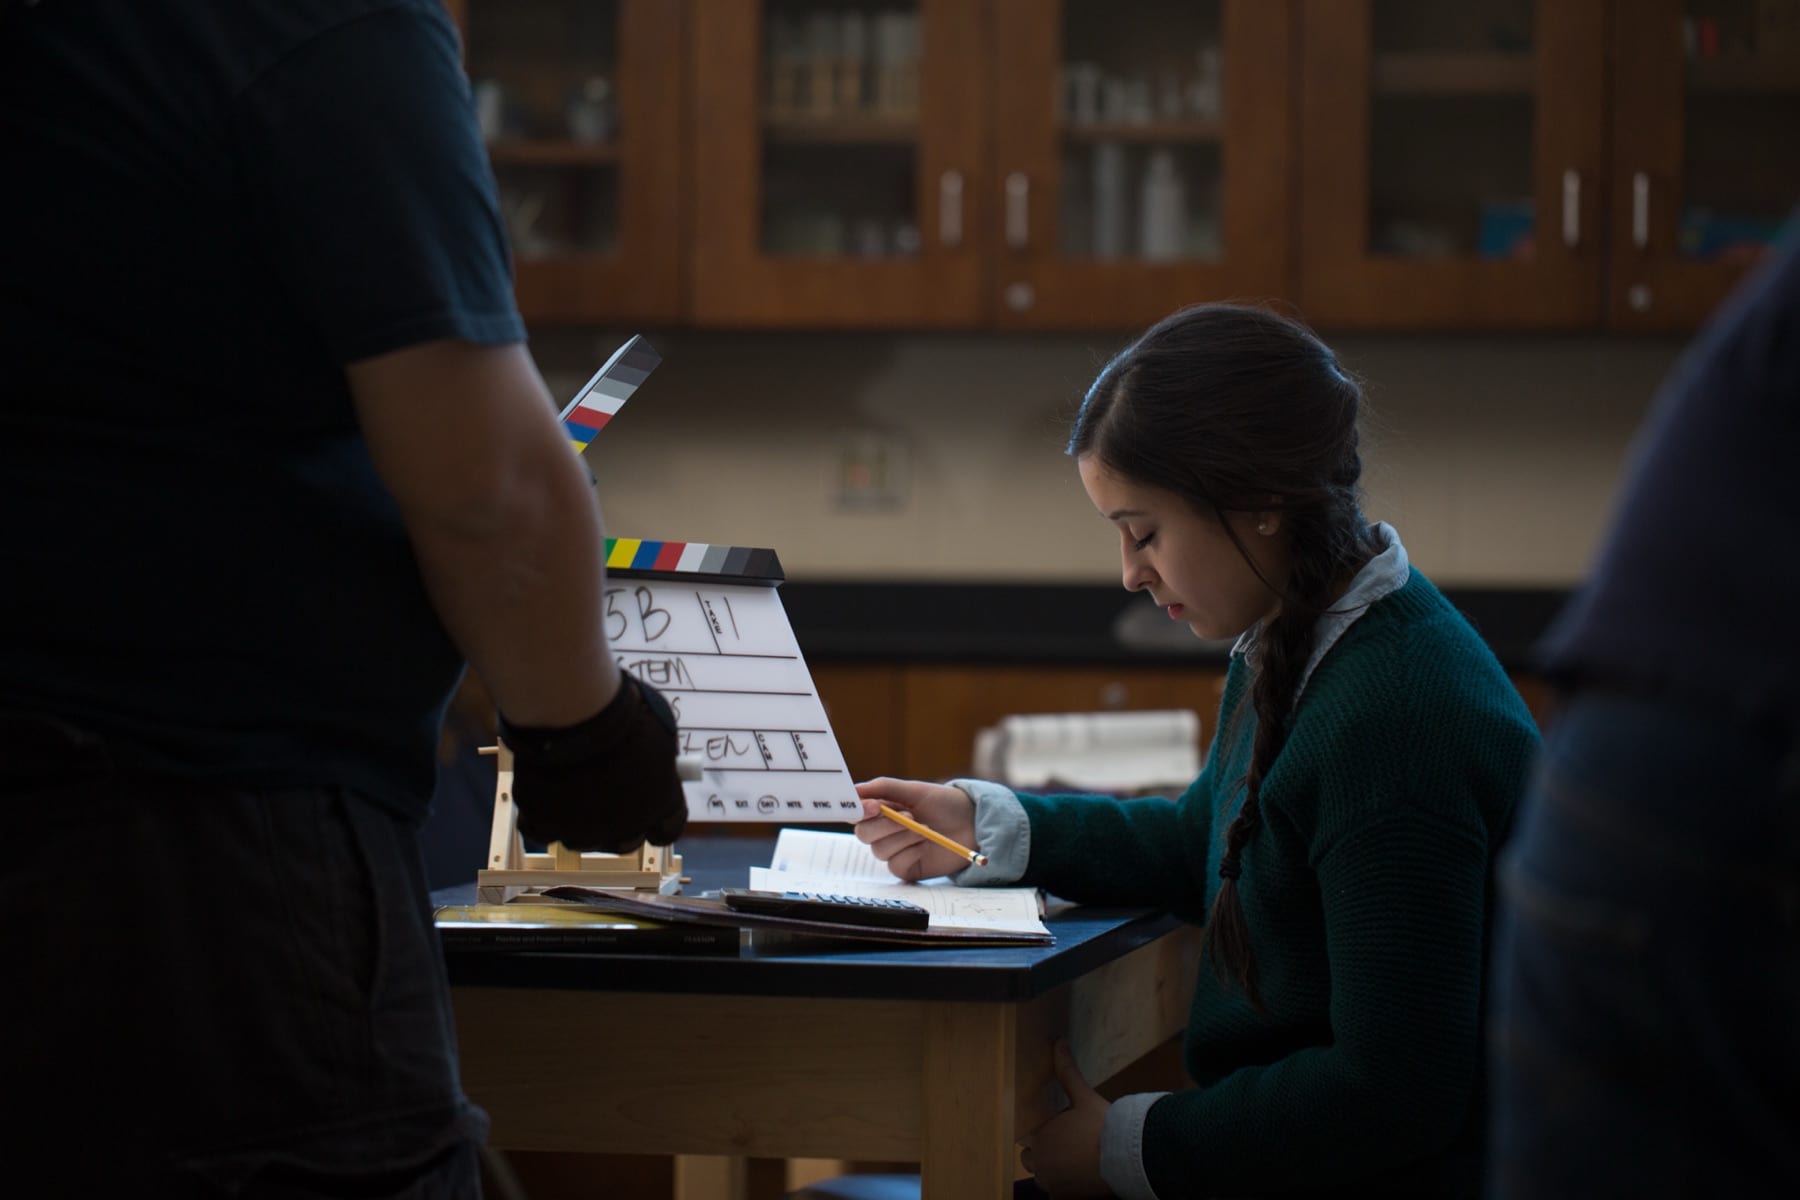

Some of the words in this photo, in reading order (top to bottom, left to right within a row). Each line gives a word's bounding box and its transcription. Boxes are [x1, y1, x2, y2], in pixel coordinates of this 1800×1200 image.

[605, 585, 672, 642] 5B
[704, 599, 723, 635] TAKE
[757, 733, 773, 761] CAM
[840, 800, 857, 809] MOS
